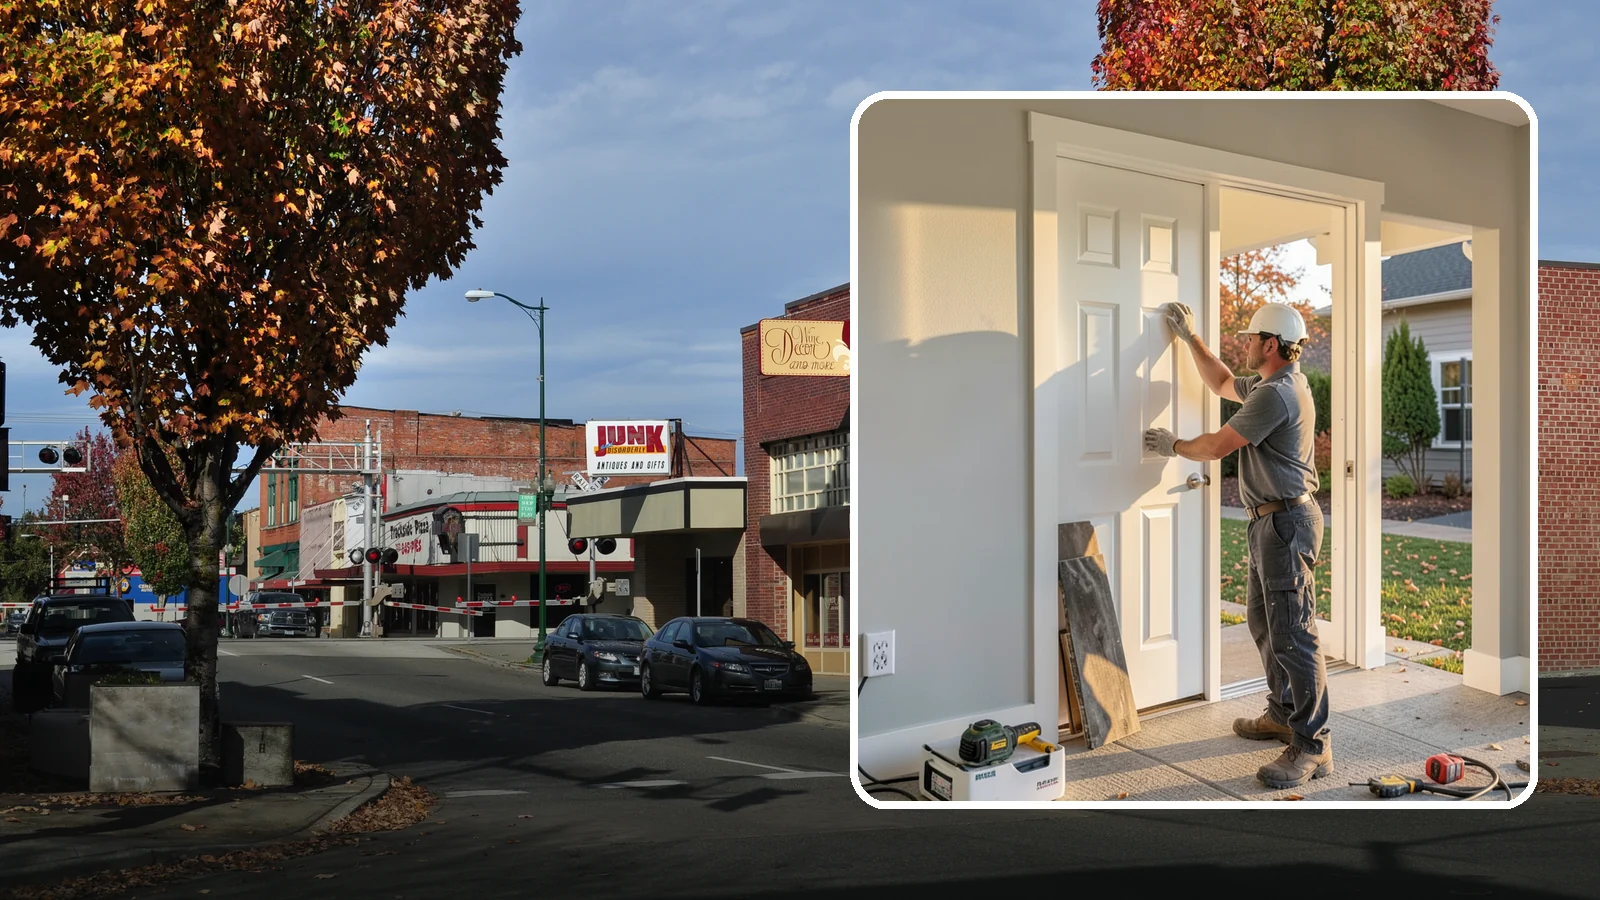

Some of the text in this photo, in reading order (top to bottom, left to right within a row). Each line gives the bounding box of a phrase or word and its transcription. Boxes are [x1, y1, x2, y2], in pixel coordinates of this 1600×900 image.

[595, 425, 665, 457] JUNK
[607, 446, 646, 454] DISORDERLY
[597, 460, 665, 470] ANTIQUES AND GIFTS
[415, 519, 429, 535] Pizza
